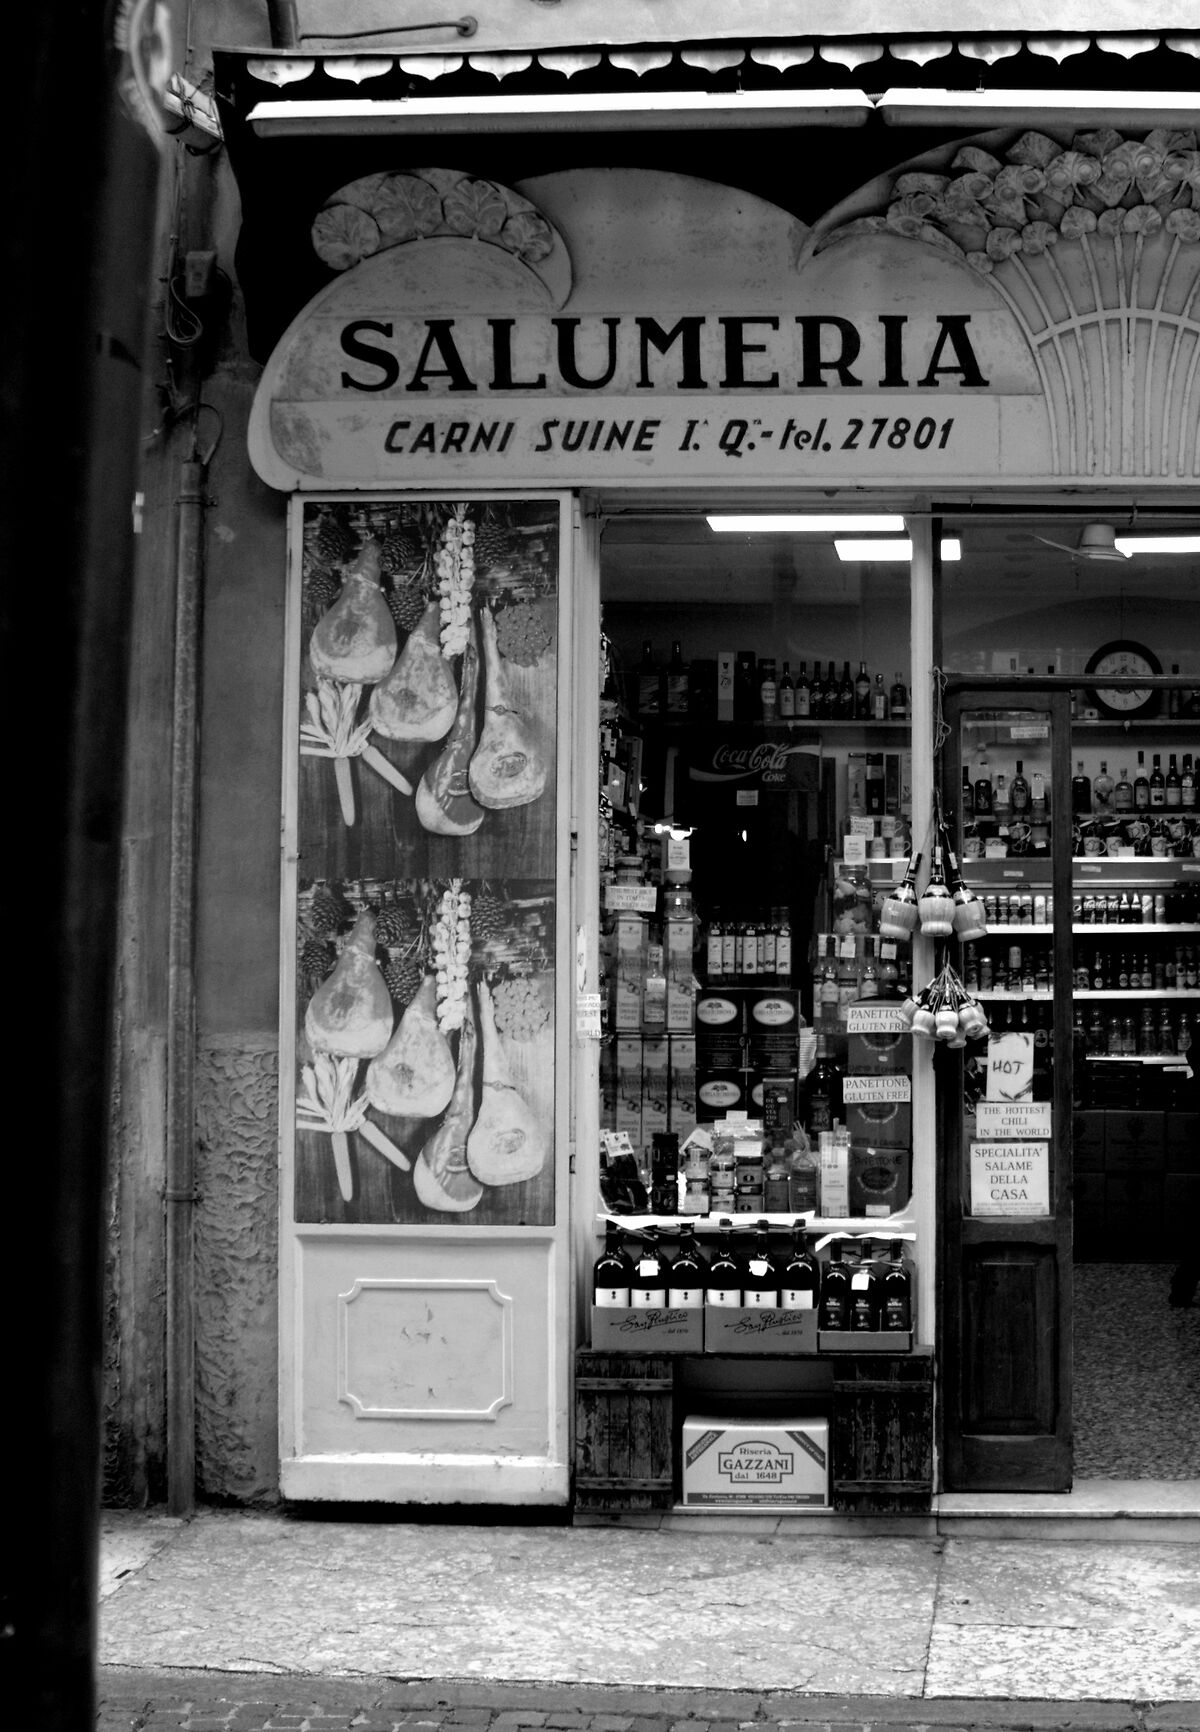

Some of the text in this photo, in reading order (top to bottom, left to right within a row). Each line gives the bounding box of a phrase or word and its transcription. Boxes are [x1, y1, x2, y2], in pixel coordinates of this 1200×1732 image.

[341, 315, 989, 392] SALUMERIA
[384, 420, 515, 454] CARNI
[536, 419, 661, 452] SUINE
[841, 417, 954, 450] 27801
[762, 771, 786, 783] Coke
[851, 1009, 902, 1020] PANETTO
[849, 1022, 887, 1032] GLUTEN
[992, 1059, 1025, 1075] HOT
[845, 1078, 909, 1091] PANETTONE
[844, 1090, 910, 1102] GLUTEN FREE
[983, 1106, 1047, 1116] THE HOTTEST
[1001, 1117, 1028, 1126] CHILI
[980, 1128, 1050, 1137] IN THE WORLD
[974, 1148, 1043, 1159] SPECIALITA'
[985, 1161, 1033, 1172] SALAME
[989, 1174, 1029, 1185] DELLA
[990, 1188, 1029, 1200] CASA
[740, 1447, 773, 1456] Riseria
[724, 1459, 789, 1471] GAZZANI
[735, 1472, 778, 1480] dal 1648
